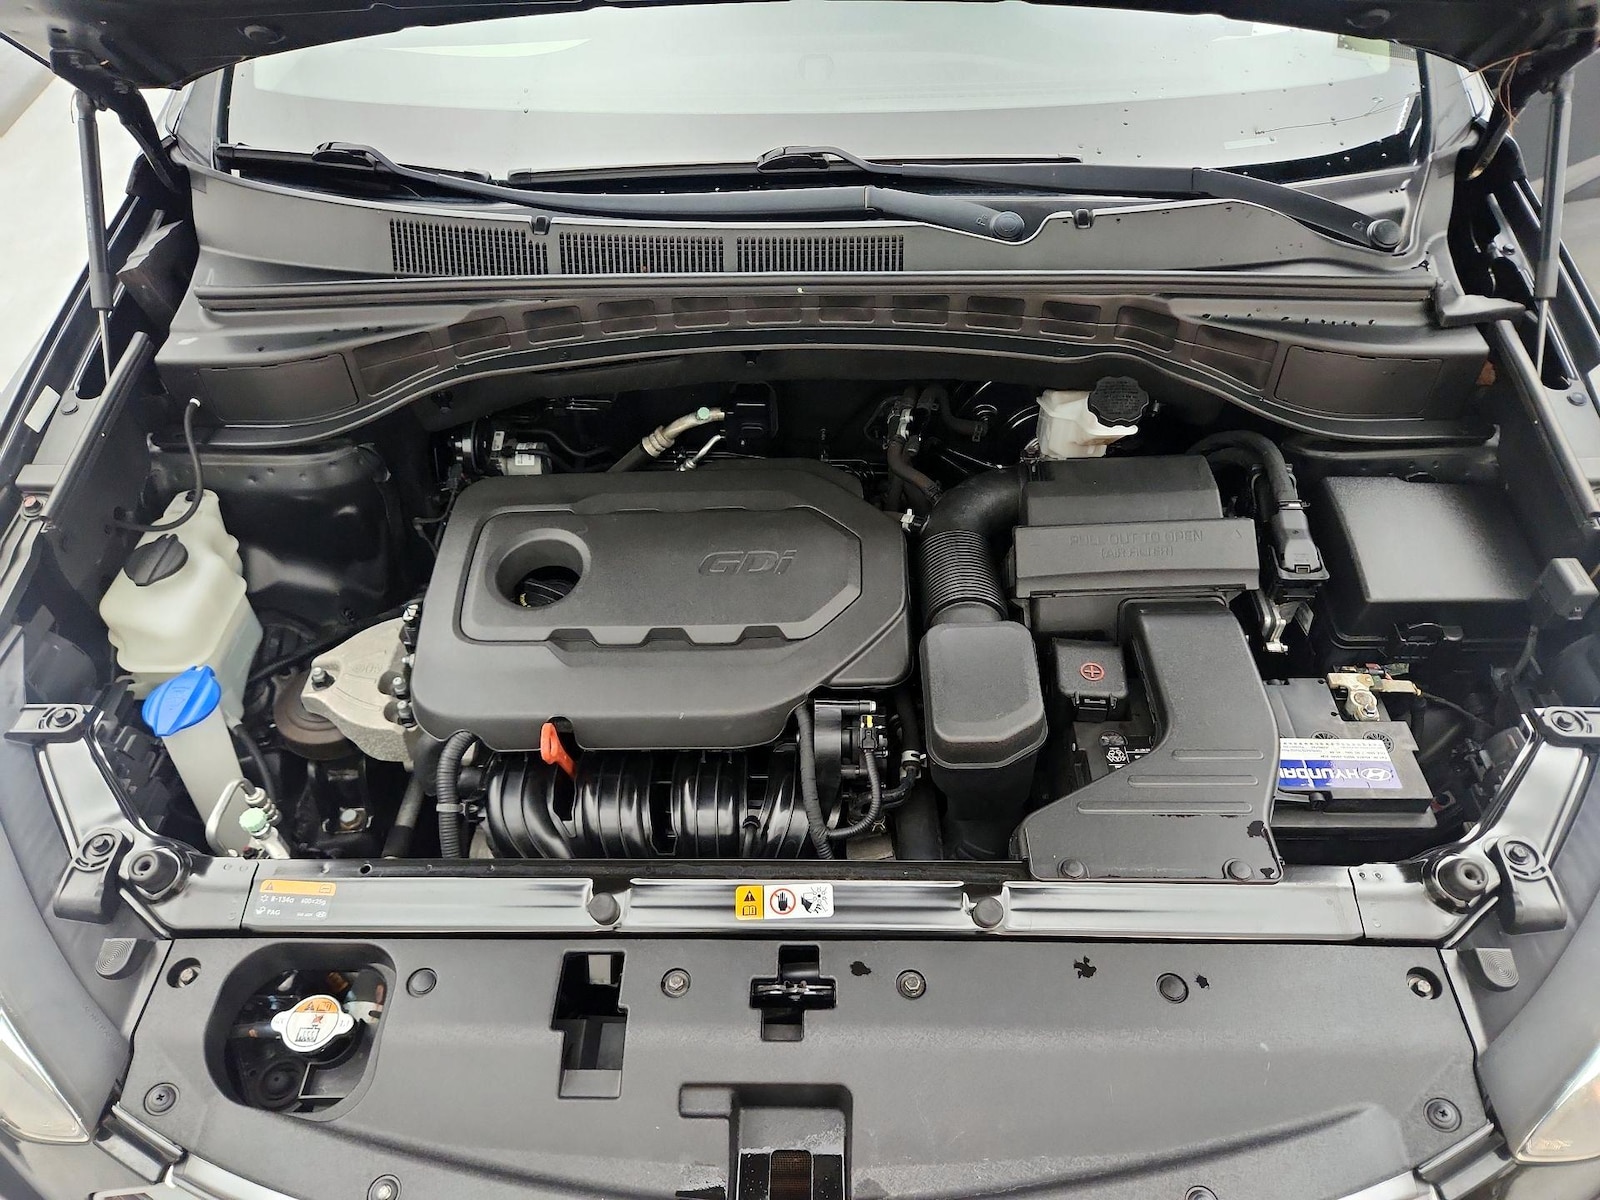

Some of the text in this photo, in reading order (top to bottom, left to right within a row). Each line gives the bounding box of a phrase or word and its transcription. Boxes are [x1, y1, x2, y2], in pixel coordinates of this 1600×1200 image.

[1069, 529, 1203, 546] PULL OUT TO OPEN
[698, 548, 798, 576] GDi
